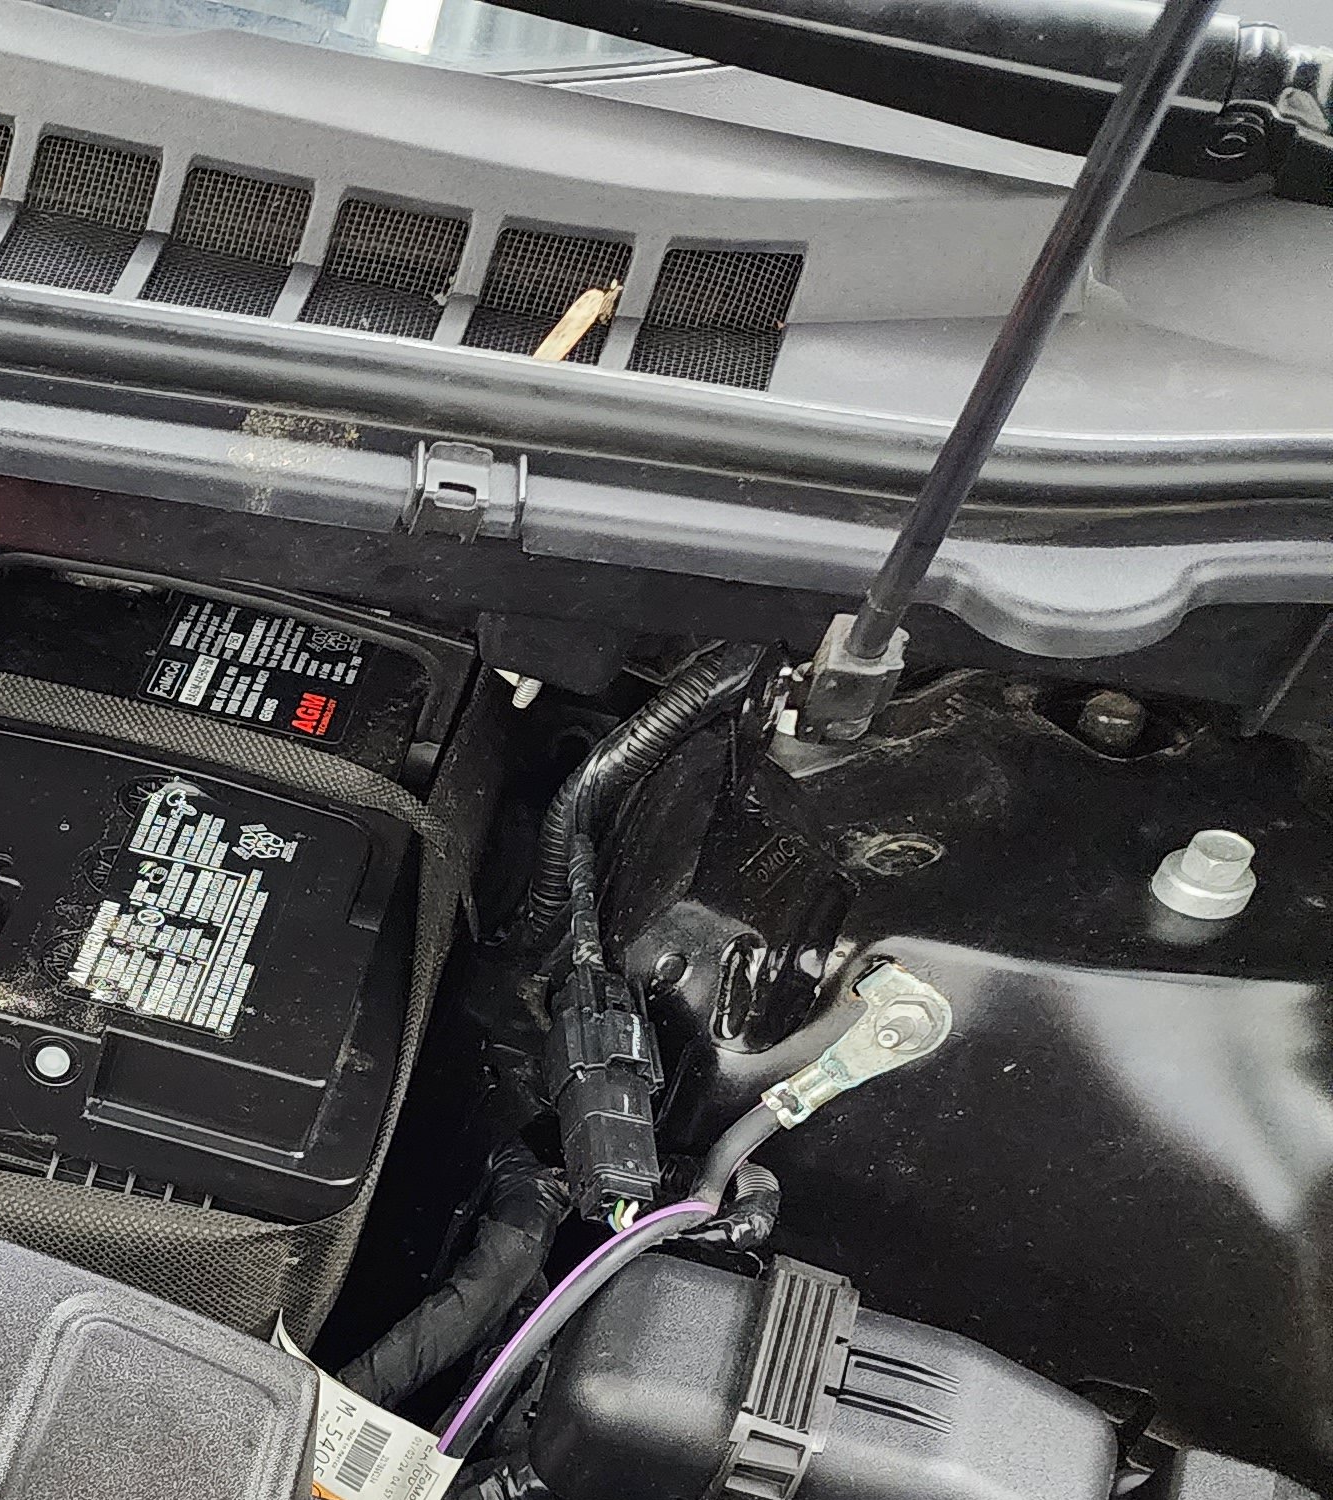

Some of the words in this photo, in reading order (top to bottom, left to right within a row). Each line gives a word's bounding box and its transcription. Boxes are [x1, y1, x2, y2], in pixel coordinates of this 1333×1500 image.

[153, 660, 180, 696] FoMoCo
[290, 691, 327, 733] AGM
[72, 898, 121, 973] DANGER/POISON
